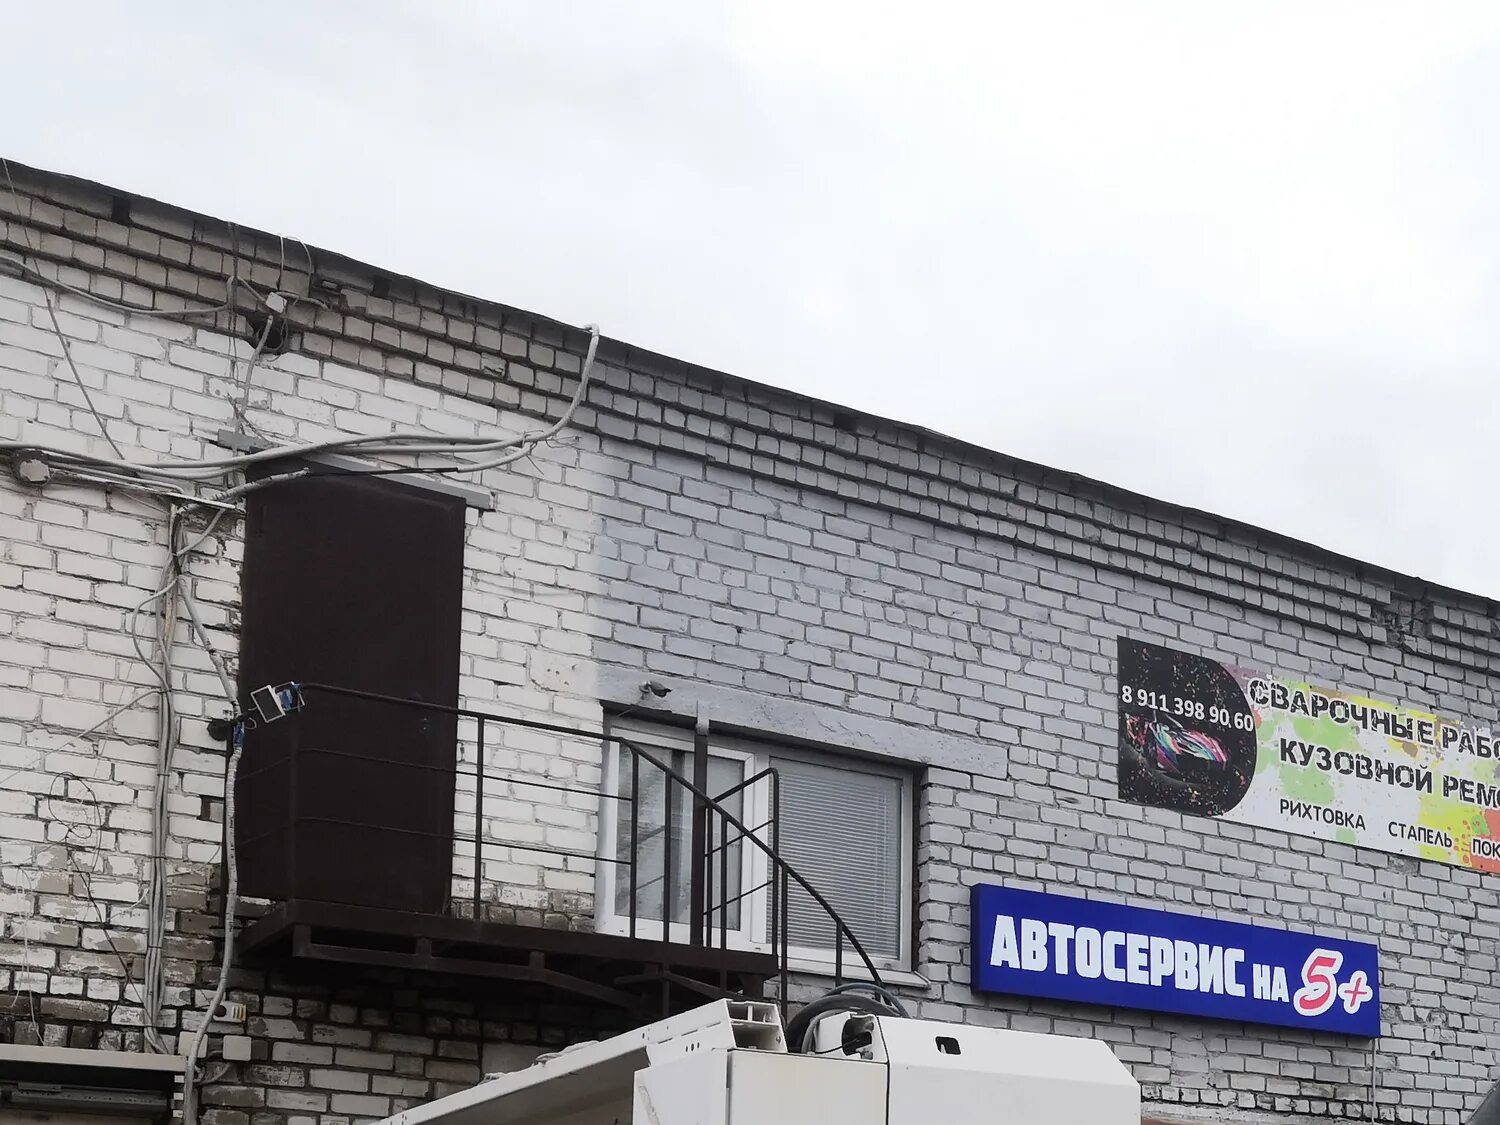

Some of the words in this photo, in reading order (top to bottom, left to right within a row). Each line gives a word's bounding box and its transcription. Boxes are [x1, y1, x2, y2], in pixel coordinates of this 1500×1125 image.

[1121, 685, 1133, 704] 8
[1137, 689, 1169, 712] 911
[1173, 697, 1205, 720] 398
[1250, 680, 1434, 745] СВАРОЧНЫЕ
[1280, 738, 1432, 793] КУЗОВНОЙ
[1280, 799, 1366, 830] РИХТОВКА
[1388, 822, 1452, 848] СТАПЕЛЬ
[990, 914, 1246, 998] АВТОСЕРВИС
[1252, 964, 1289, 1003] НА
[1294, 948, 1373, 1016] 5+
